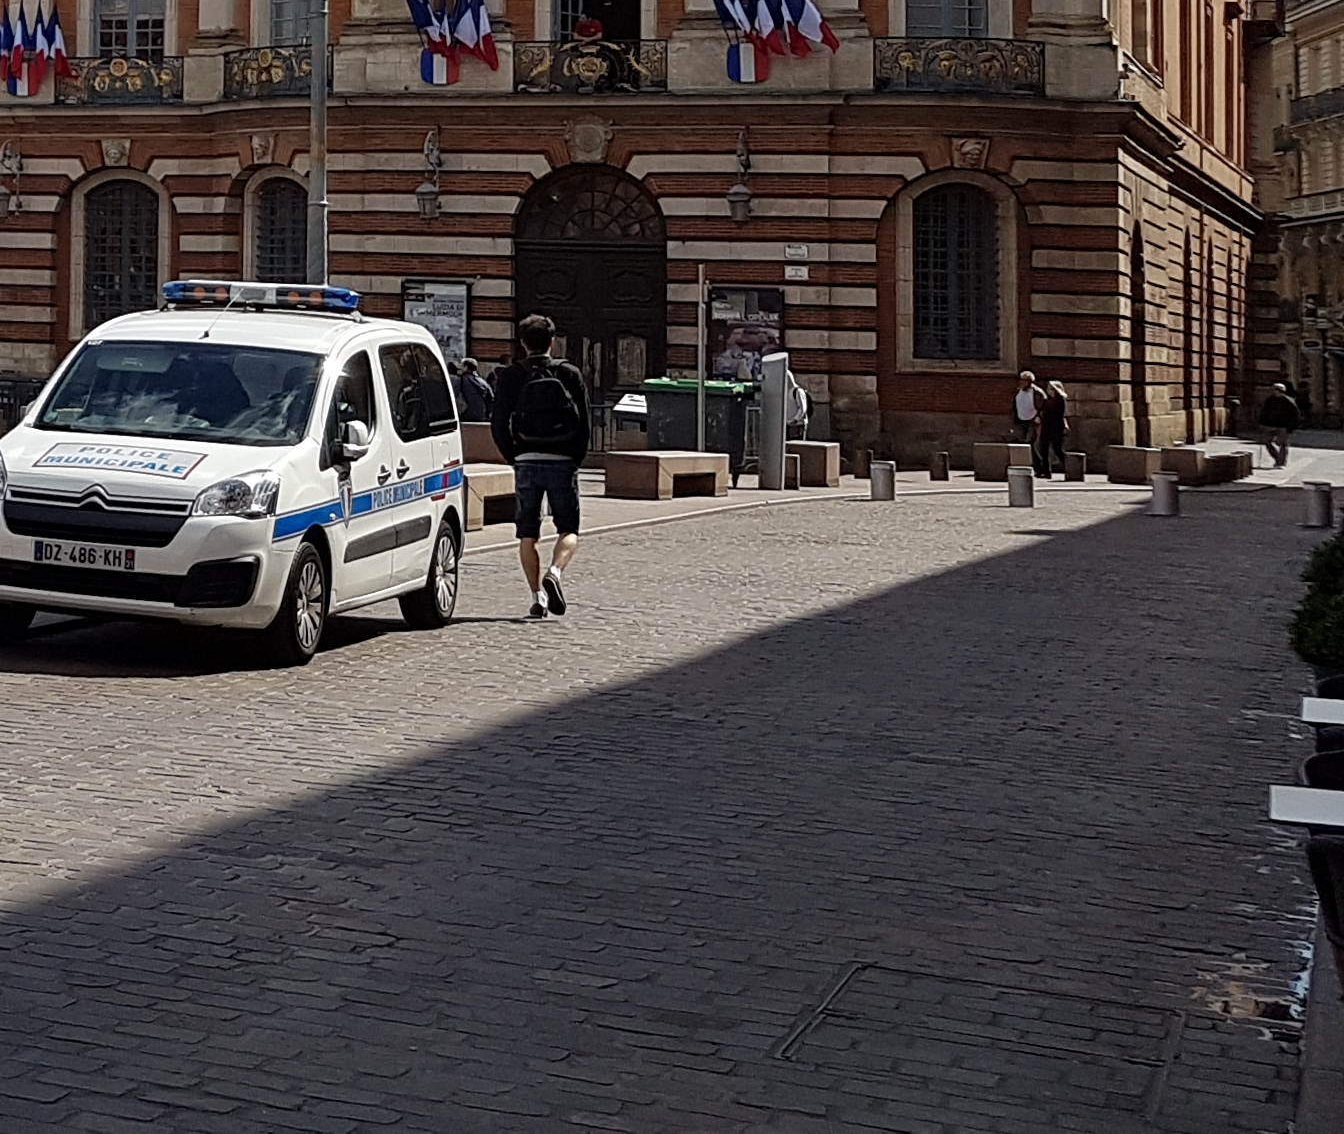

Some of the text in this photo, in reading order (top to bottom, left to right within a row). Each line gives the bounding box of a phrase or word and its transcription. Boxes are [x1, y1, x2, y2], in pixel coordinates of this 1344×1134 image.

[78, 446, 173, 461] POLICE
[42, 455, 188, 474] MUNICIPALE
[374, 488, 392, 509] POLICE
[44, 543, 122, 568] DZ-486-KH
